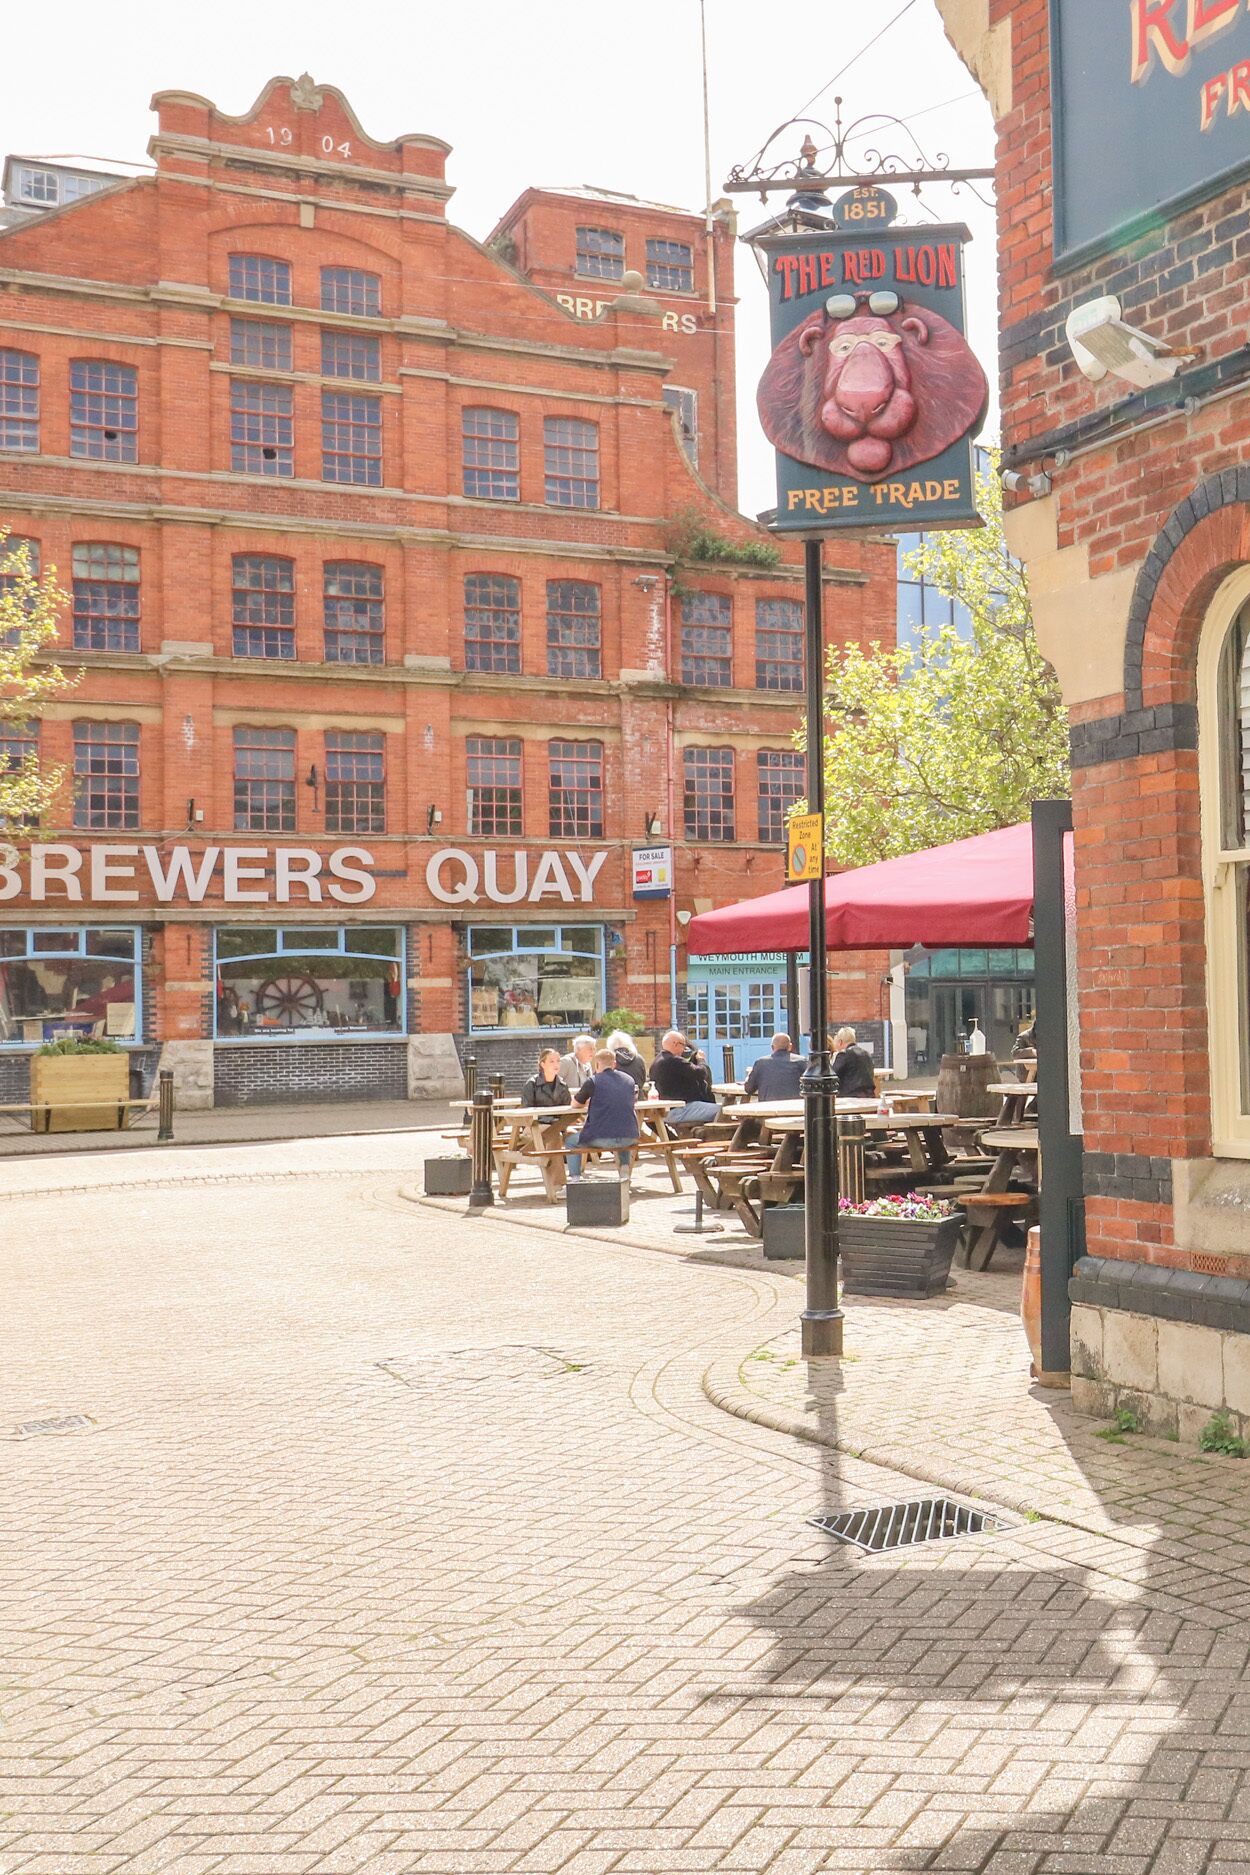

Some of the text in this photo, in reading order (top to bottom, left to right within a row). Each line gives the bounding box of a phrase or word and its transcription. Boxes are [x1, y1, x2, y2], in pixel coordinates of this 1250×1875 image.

[266, 127, 352, 158] 19 04
[853, 187, 879, 199] EST.
[843, 201, 885, 221] 1851
[775, 243, 957, 299] THE RED LION
[787, 479, 961, 514] FREE TRADE
[792, 820, 819, 829] Restricted
[799, 831, 811, 839] Zone
[638, 851, 665, 861] FOR SALE
[425, 848, 609, 904] QUAY
[760, 952, 804, 962] MUSEM
[709, 966, 778, 975] MAIN ENTRANCE
